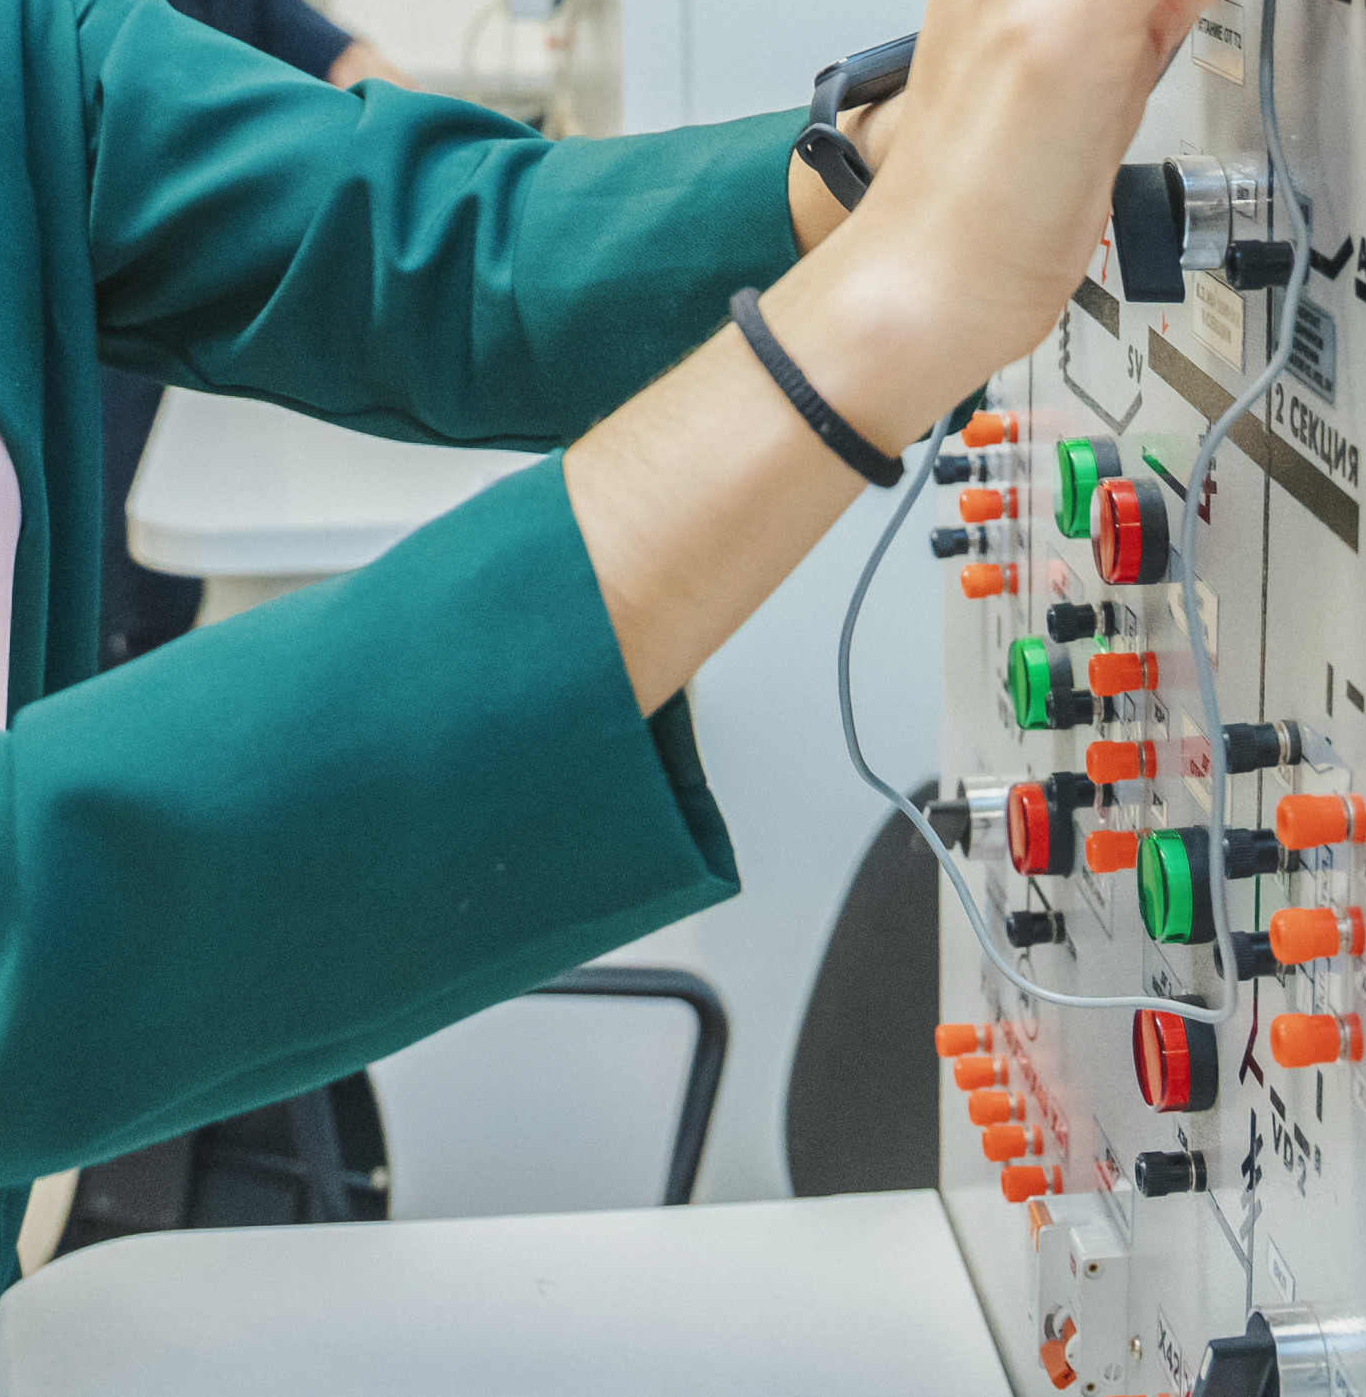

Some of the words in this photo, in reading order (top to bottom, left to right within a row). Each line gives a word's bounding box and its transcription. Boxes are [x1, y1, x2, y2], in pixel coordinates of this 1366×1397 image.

[1127, 344, 1144, 385] SV
[1275, 382, 1286, 426] 2
[1290, 395, 1360, 490] СЕКЦИЯ
[1271, 1110, 1295, 1174] VD
[1297, 1154, 1308, 1200] 2
